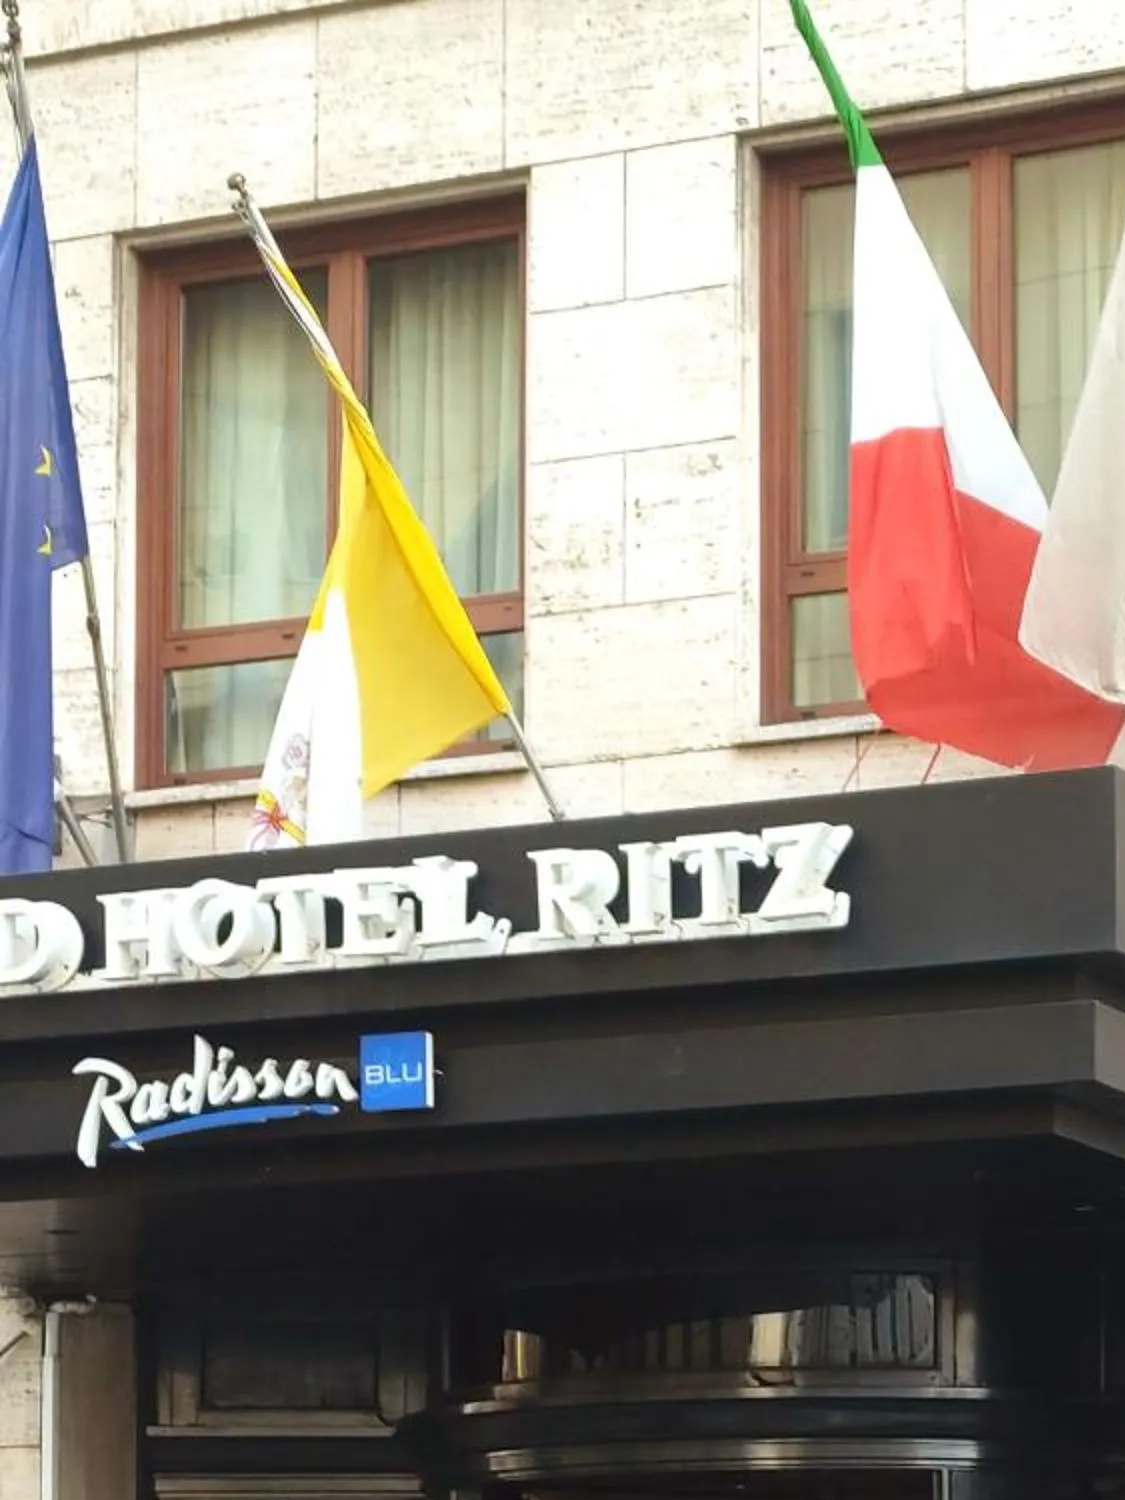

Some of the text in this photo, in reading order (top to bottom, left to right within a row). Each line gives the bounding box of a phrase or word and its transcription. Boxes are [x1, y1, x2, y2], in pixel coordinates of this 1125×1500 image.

[96, 855, 511, 978] HOTEL
[527, 822, 854, 944] RITZ
[72, 1034, 423, 1168] Radisson BLU
